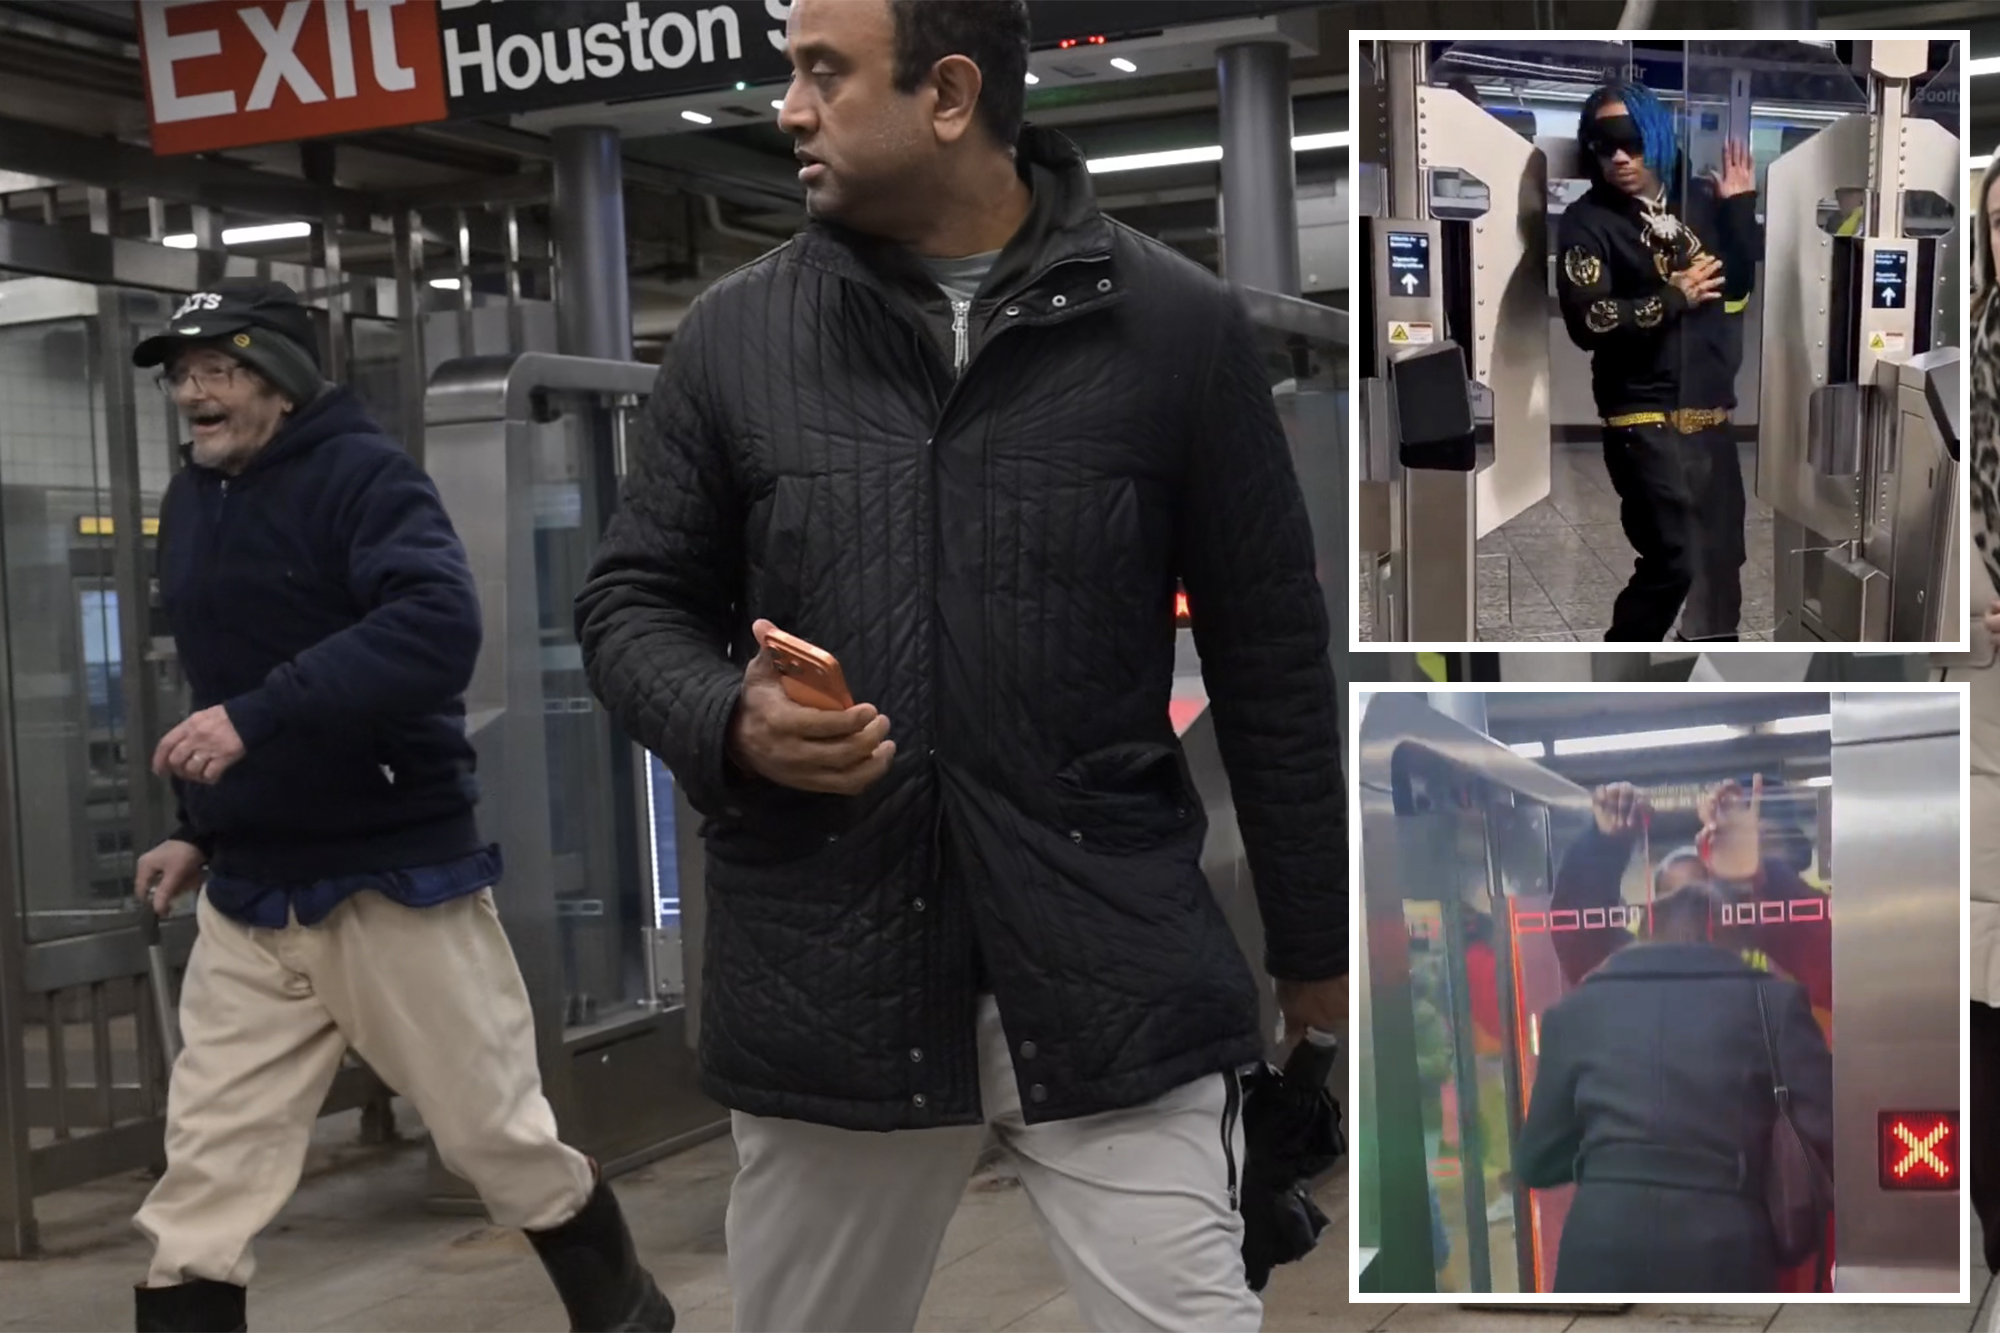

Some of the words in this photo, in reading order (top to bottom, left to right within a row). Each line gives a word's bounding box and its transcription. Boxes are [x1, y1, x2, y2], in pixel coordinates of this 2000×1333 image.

[140, 0, 416, 124] Exit
[444, 2, 742, 97] Houston
[1915, 86, 1959, 103] Booth
